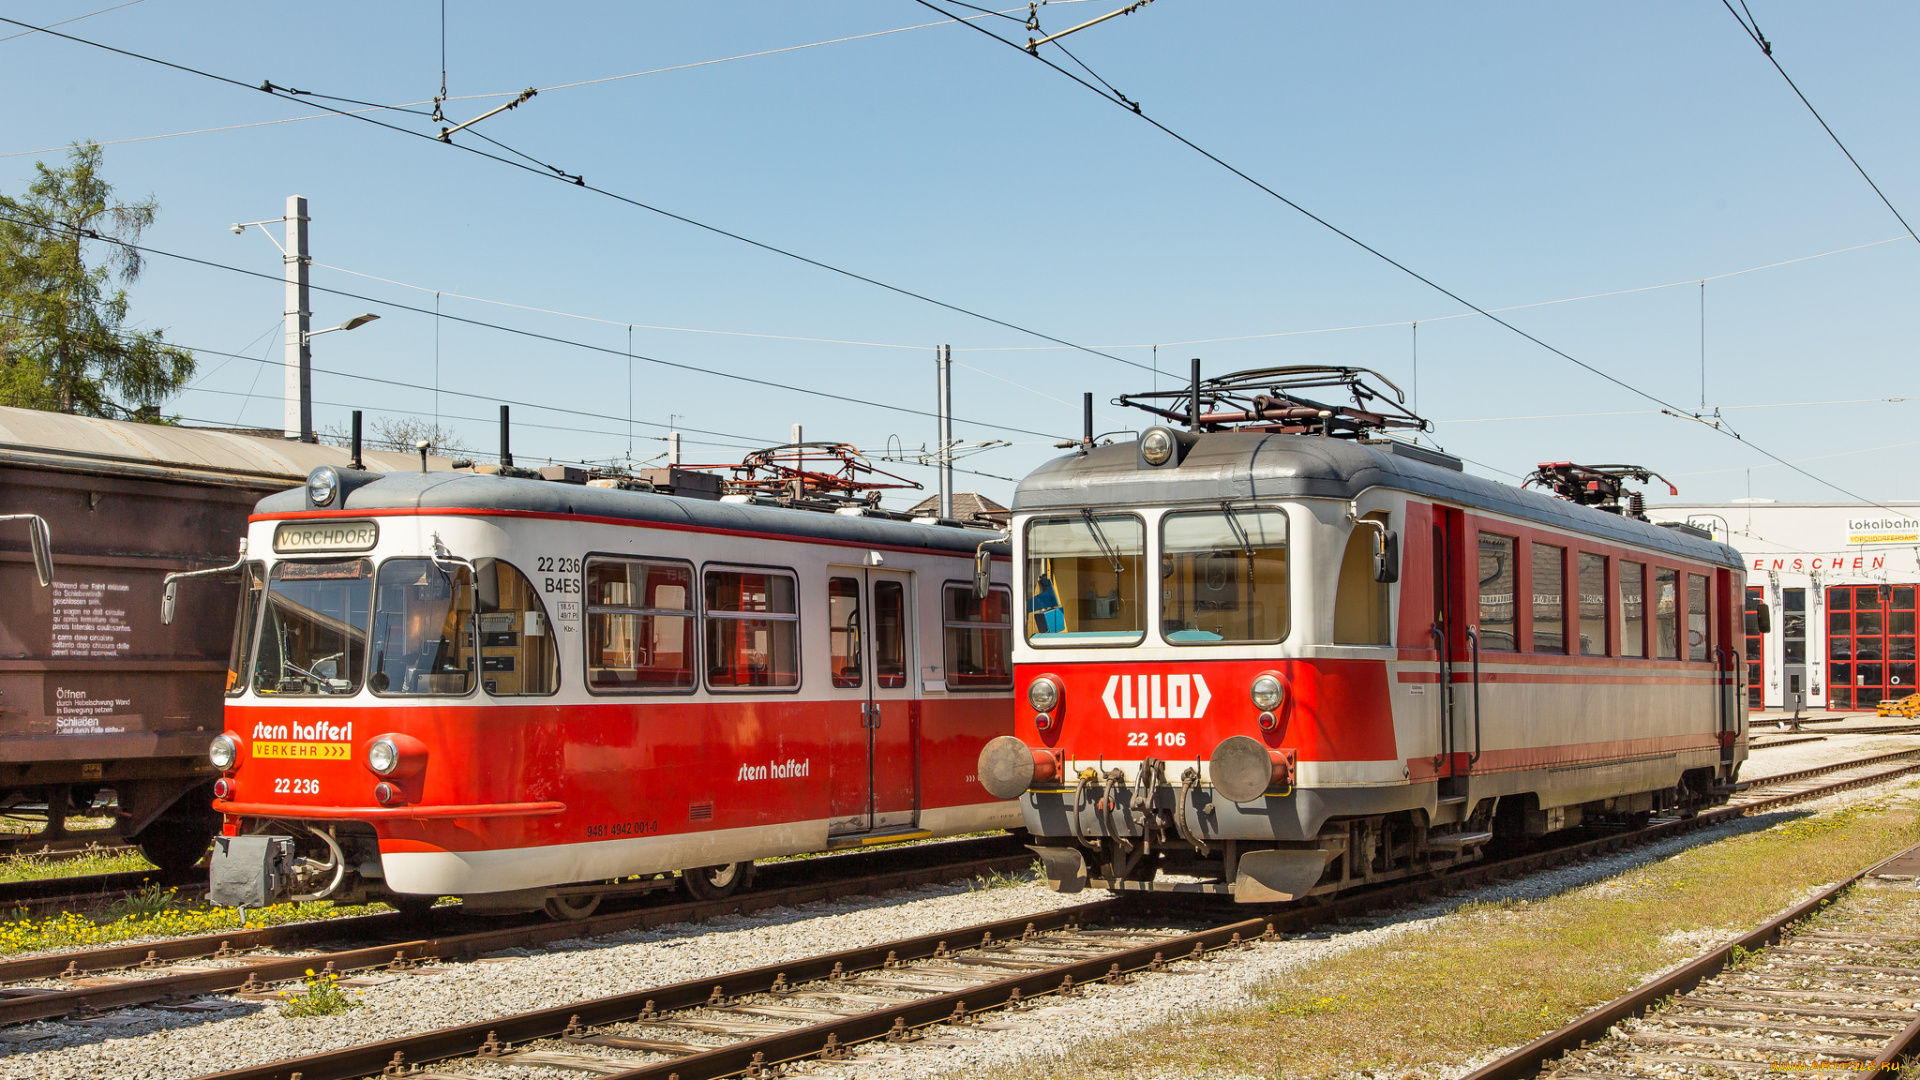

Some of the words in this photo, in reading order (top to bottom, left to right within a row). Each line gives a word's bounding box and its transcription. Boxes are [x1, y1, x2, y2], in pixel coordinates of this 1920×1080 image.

[1849, 518, 1919, 530] Lokalbahn
[280, 528, 375, 546] VORCHDORF
[537, 557, 554, 572] 22
[558, 557, 581, 573] 236
[1753, 557, 1885, 570] ENSCHEN
[545, 578, 580, 594] B4ES
[56, 687, 86, 699] Öffnen
[1122, 674, 1192, 719] LILO
[63, 707, 93, 715] Bewegung
[56, 715, 99, 727] Schließen
[252, 721, 288, 740] stern
[293, 721, 352, 741] hafferl
[1127, 732, 1149, 747] 22
[1154, 732, 1186, 747] 106
[257, 745, 317, 757] VERKEHR
[737, 763, 767, 781] stern
[770, 758, 809, 779] hafferl
[274, 778, 290, 793] 22
[293, 779, 320, 794] 236
[586, 824, 608, 838] 9481
[611, 822, 632, 836] 4942
[634, 820, 658, 834] 001-0
